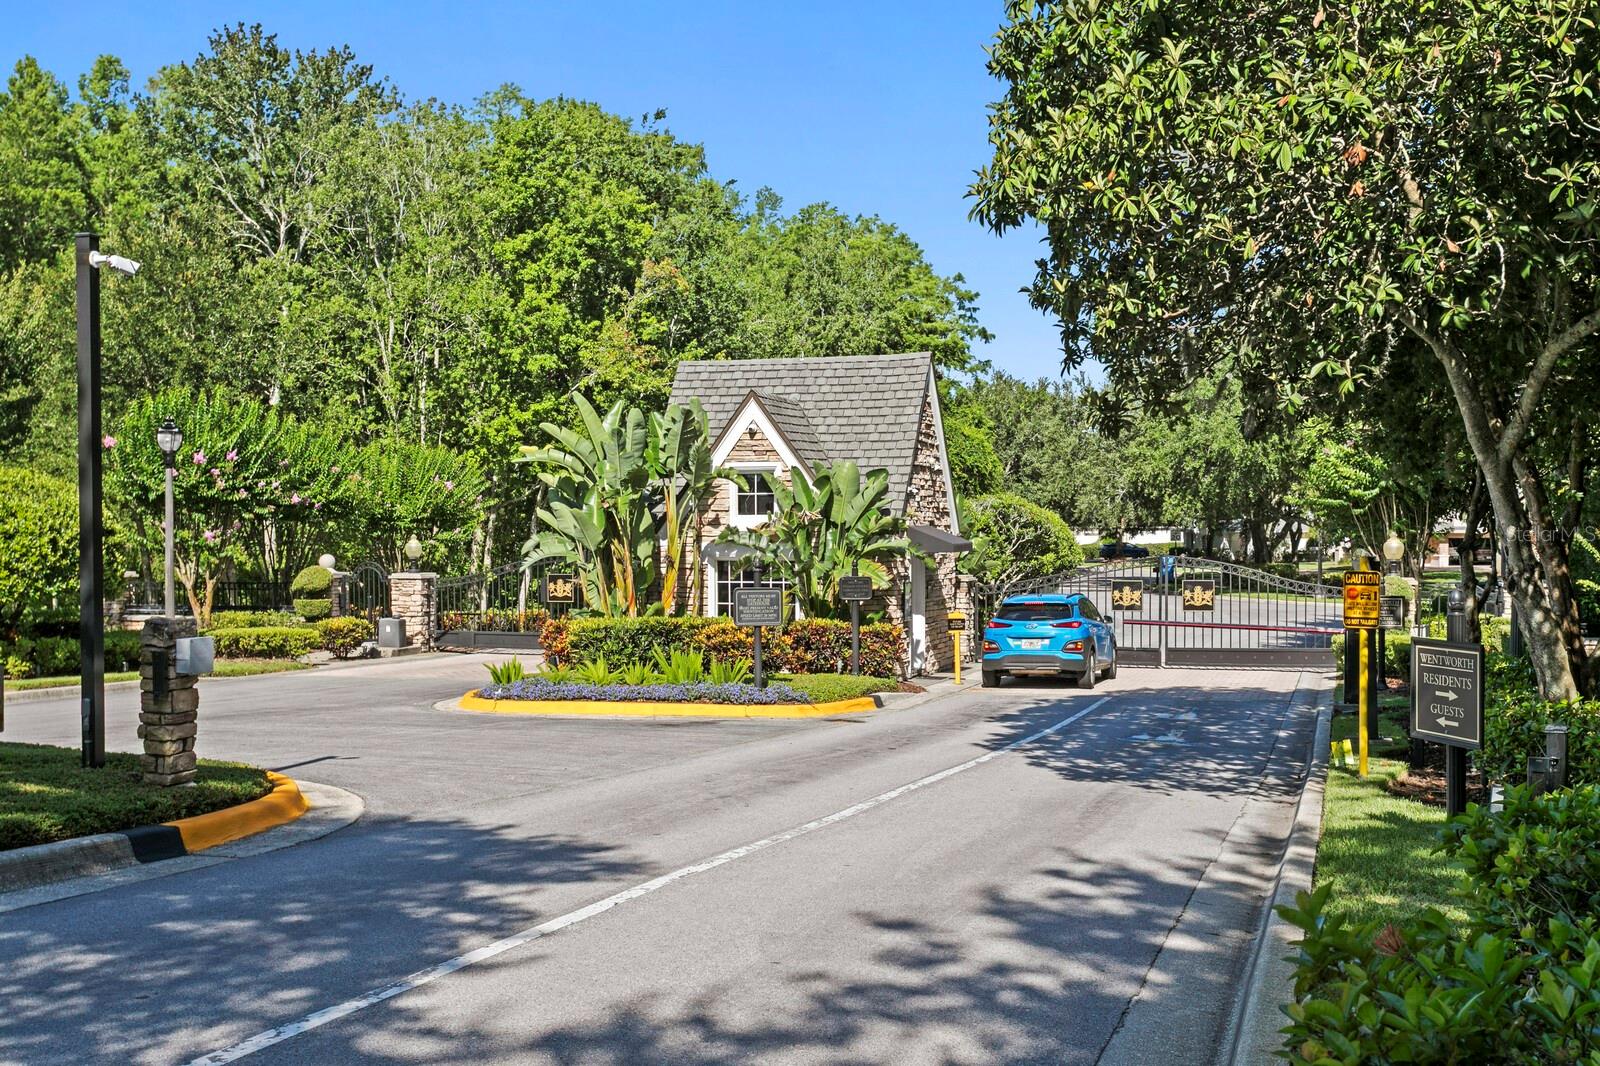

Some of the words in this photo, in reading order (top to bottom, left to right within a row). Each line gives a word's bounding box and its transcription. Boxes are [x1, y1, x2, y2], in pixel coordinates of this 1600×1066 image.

[1345, 573, 1379, 585] CAUTION
[1420, 652, 1474, 669] WENTWORTH
[1423, 672, 1472, 690] RESIDENTS
[1430, 703, 1464, 719] GUESTS
